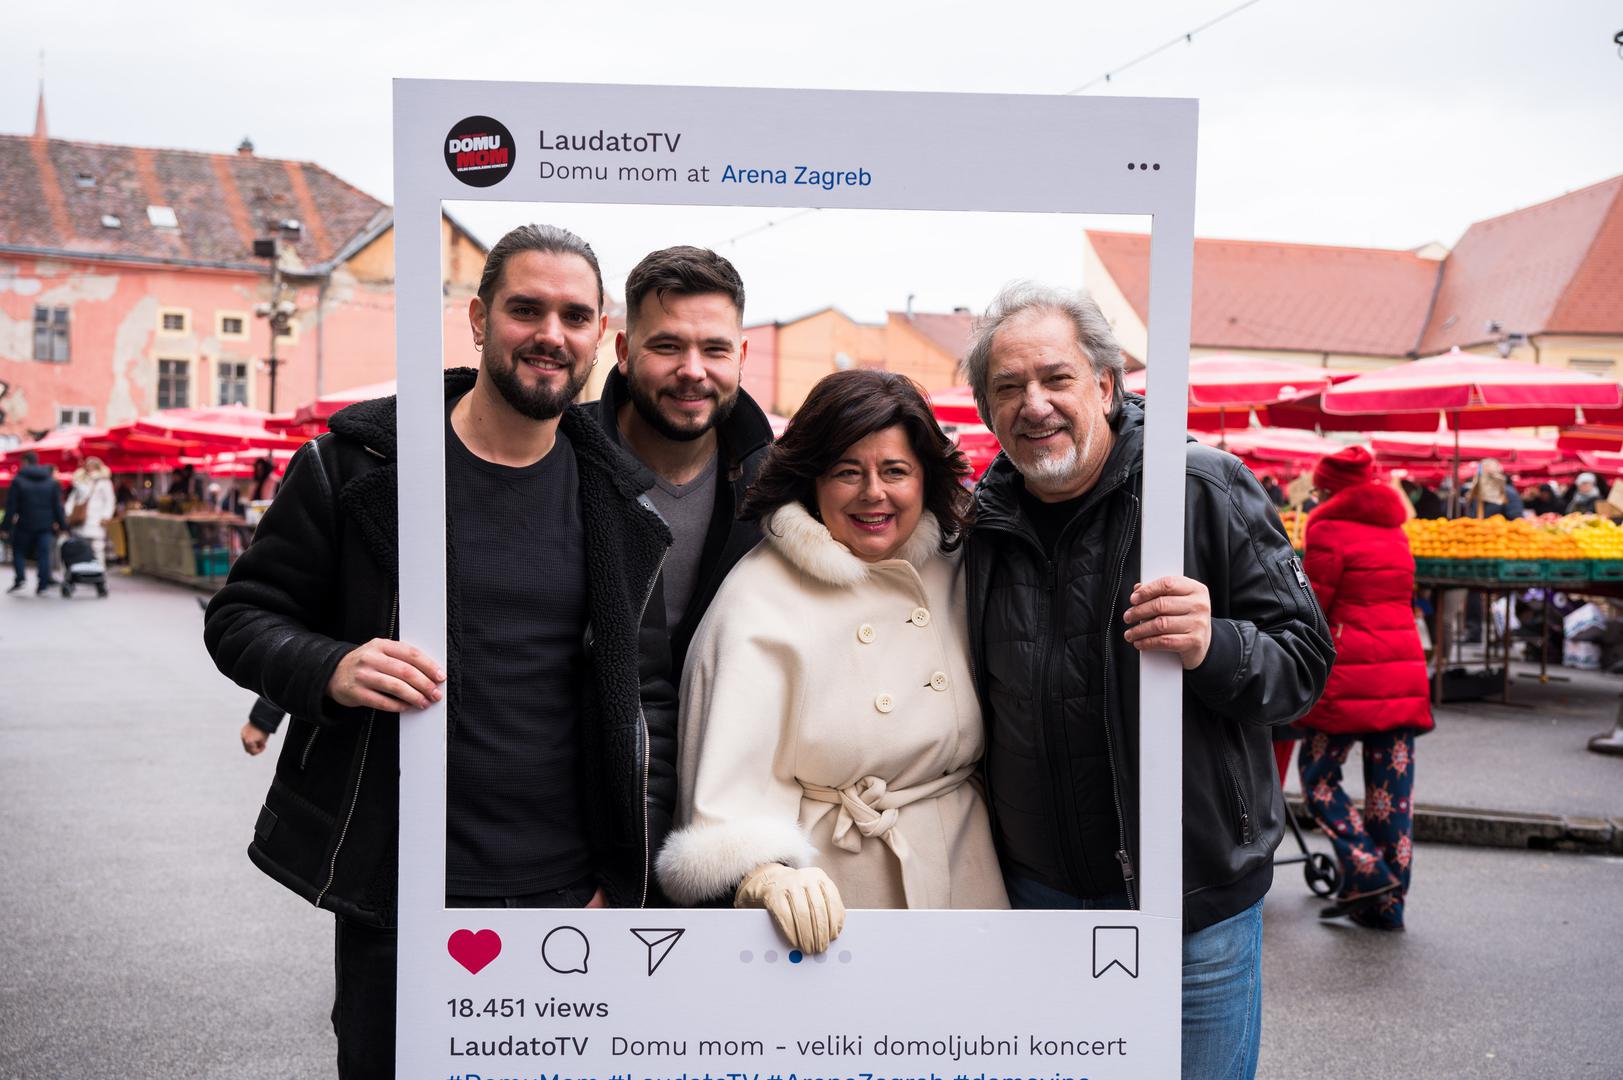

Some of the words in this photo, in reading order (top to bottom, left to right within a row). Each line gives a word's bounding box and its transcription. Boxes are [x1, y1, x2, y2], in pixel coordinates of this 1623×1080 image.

[449, 135, 501, 153] DOMU
[539, 129, 682, 154] LaudatoTV
[456, 147, 509, 168] MOM
[539, 161, 608, 181] Domu
[618, 166, 677, 182] mom
[687, 165, 711, 183] at
[720, 164, 787, 186] Arena
[793, 165, 872, 191] Zagreb
[447, 998, 525, 1018] 18.451
[534, 996, 609, 1018] views
[449, 1034, 589, 1057] LaudatoTV
[611, 1036, 687, 1056] Domu
[699, 1040, 764, 1056] mom
[796, 1034, 863, 1056] veliki
[873, 1034, 1019, 1062] domoljubni
[1030, 1034, 1128, 1056] koncert
